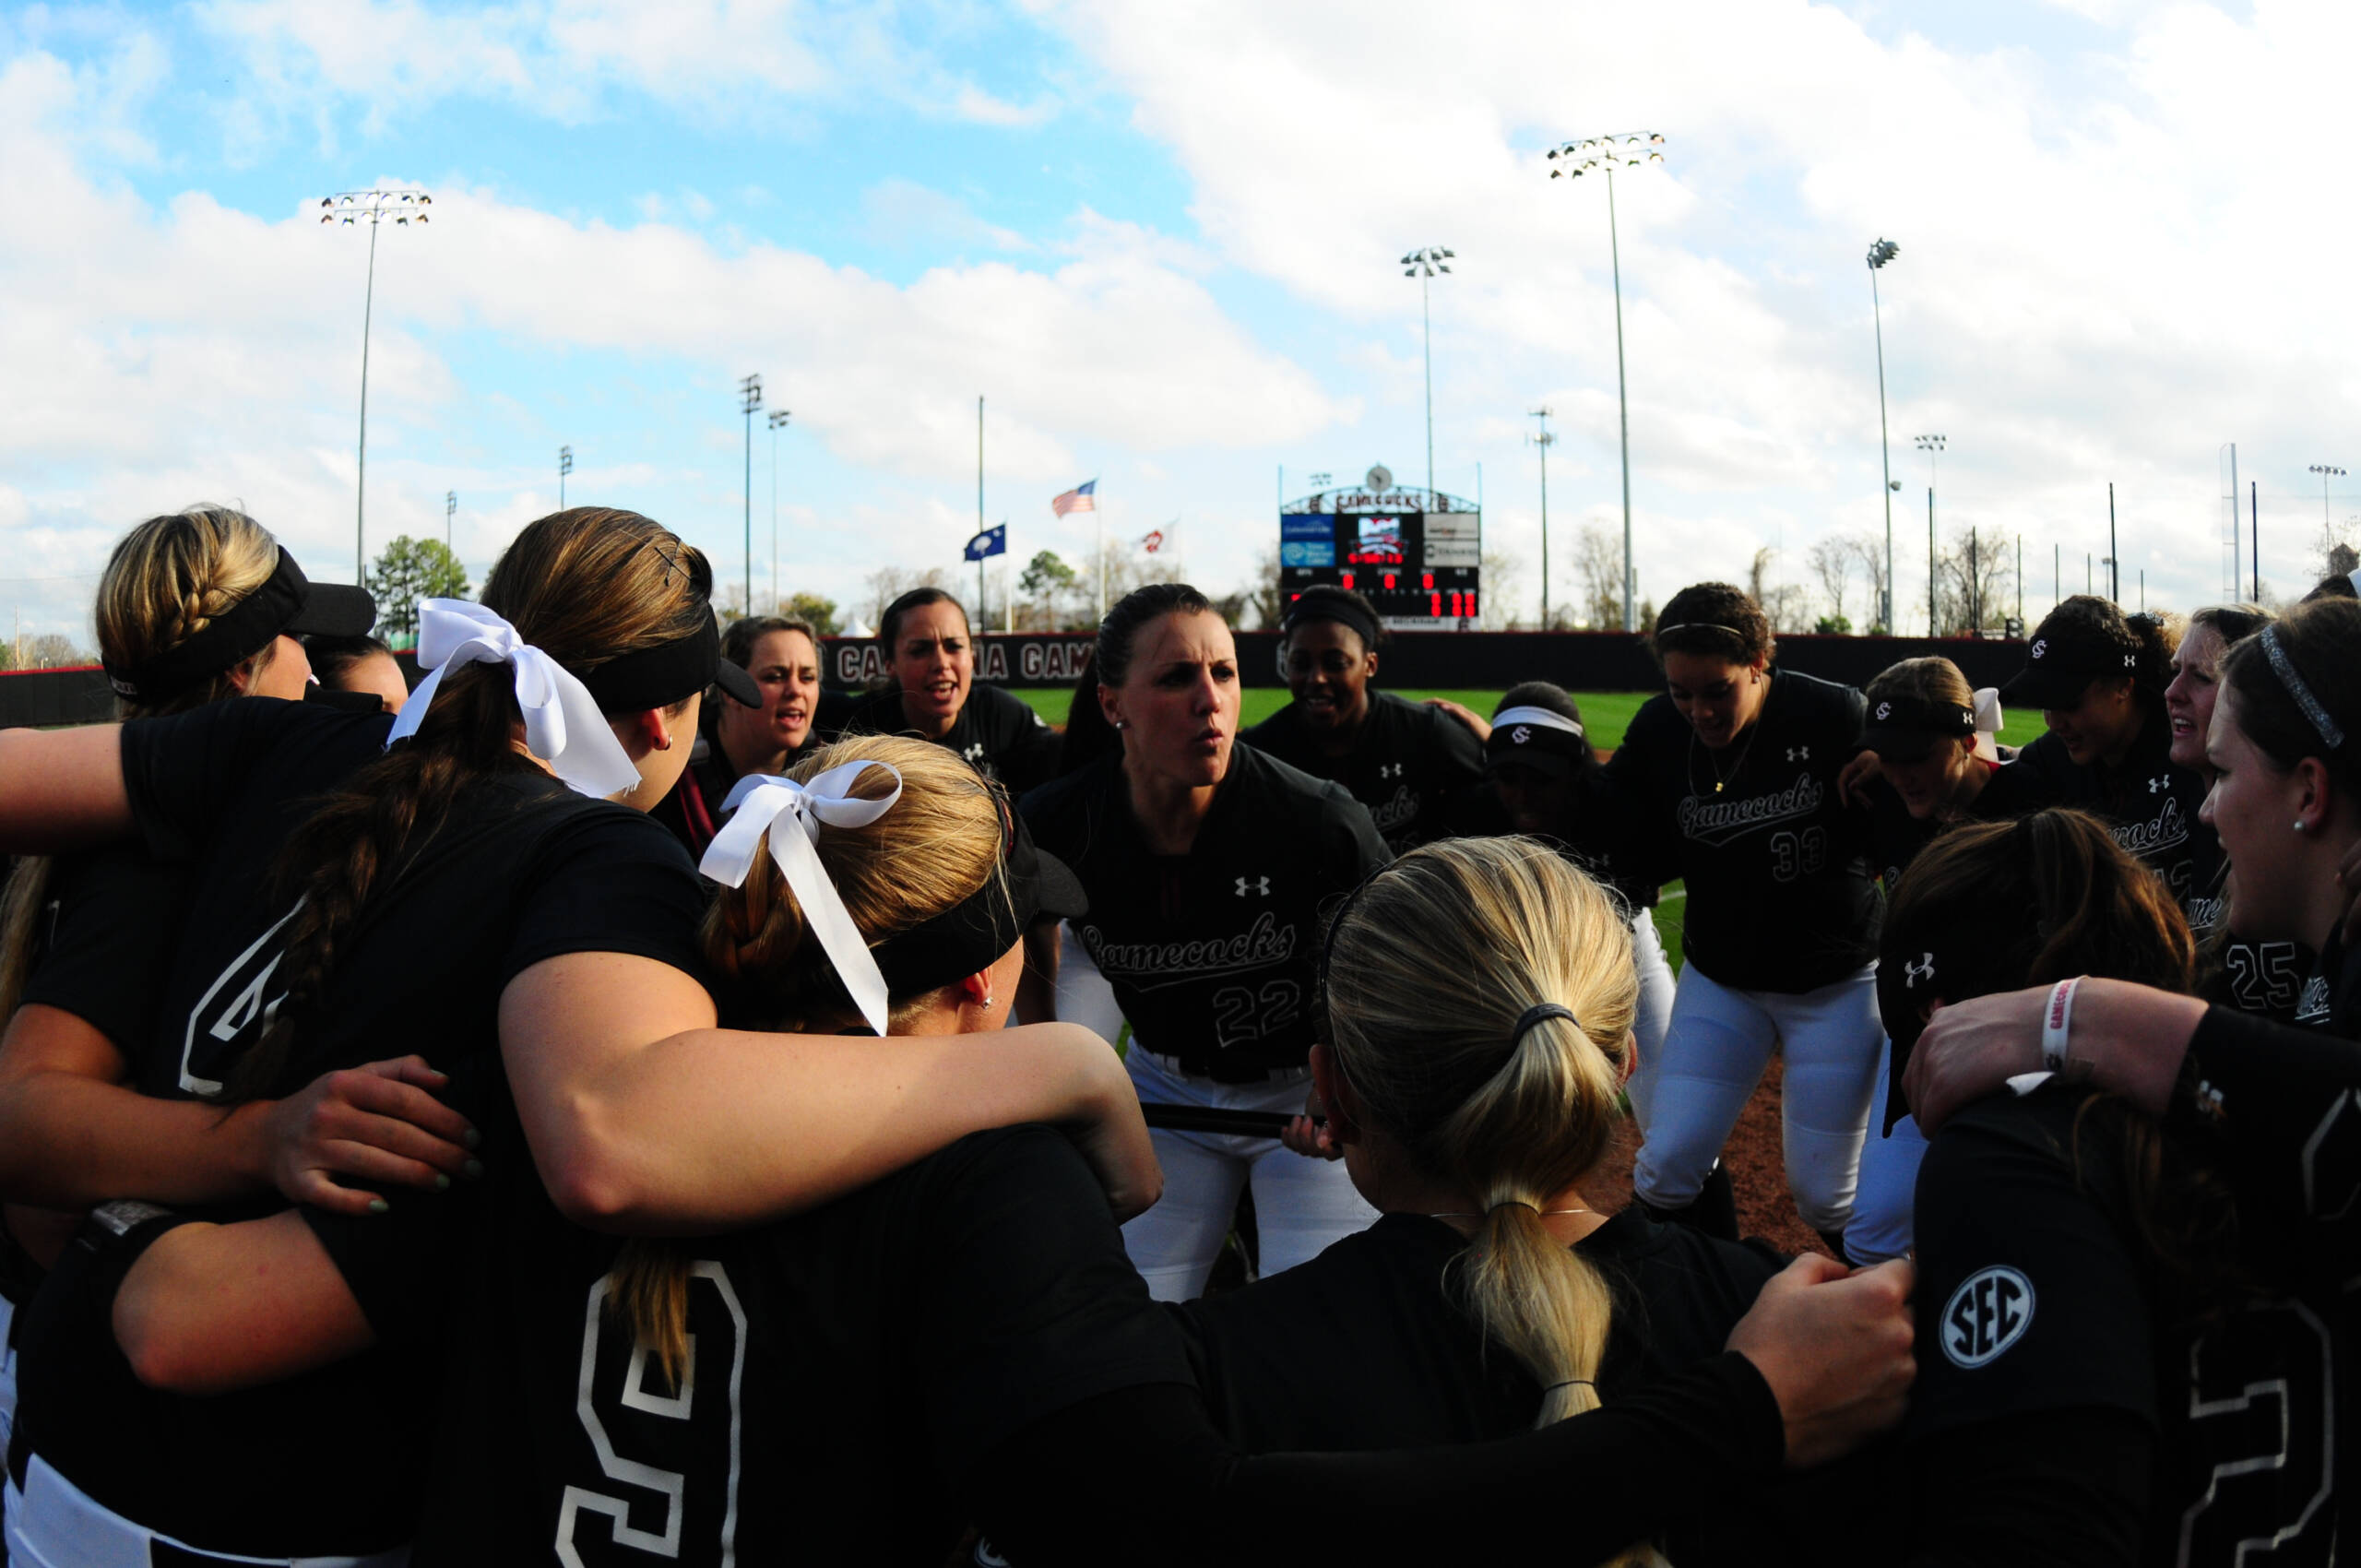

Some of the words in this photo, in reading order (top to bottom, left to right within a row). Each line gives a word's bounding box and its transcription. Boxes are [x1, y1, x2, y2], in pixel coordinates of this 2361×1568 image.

[1677, 771, 1824, 838] Gamecocks
[1770, 826, 1828, 884] 33
[2226, 941, 2304, 1011] 25
[1212, 979, 1301, 1049] 22
[1950, 1276, 2023, 1358] SEC
